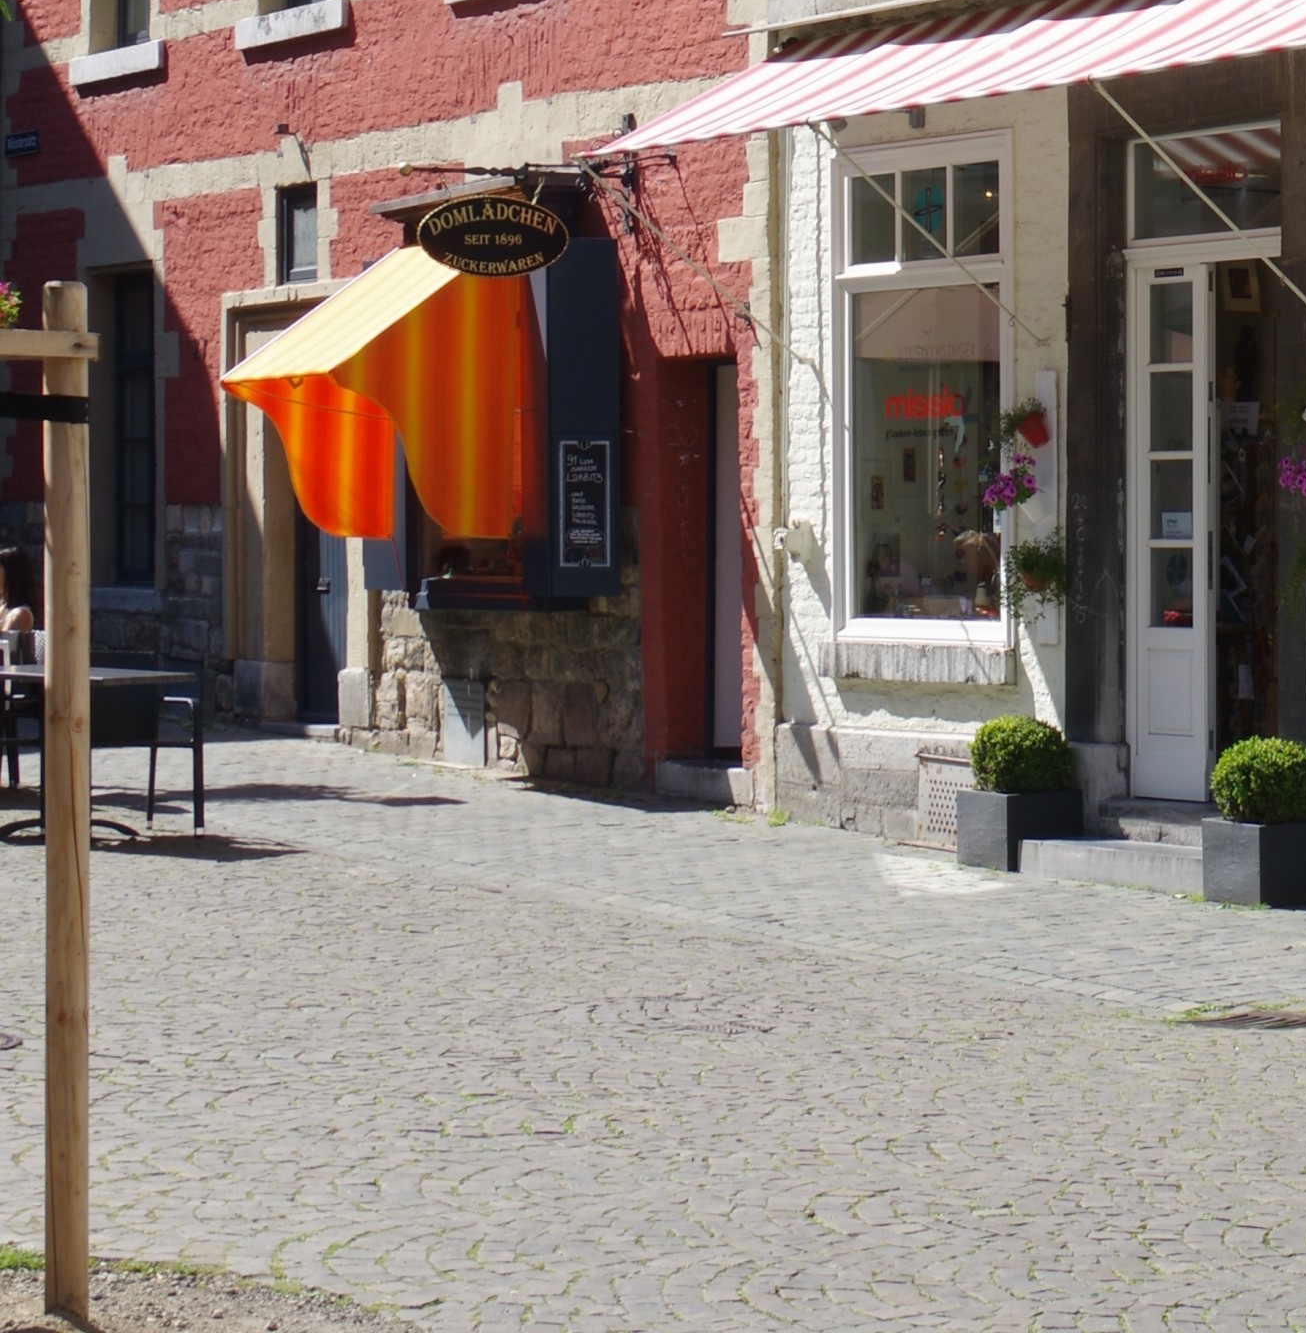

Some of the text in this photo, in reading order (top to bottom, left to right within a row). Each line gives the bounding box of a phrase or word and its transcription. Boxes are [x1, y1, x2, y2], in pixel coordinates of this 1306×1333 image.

[428, 199, 558, 235] DOMLÄDCHEN
[464, 234, 523, 246] SEIT 1896
[442, 251, 545, 274] ZUCKERWAREN
[885, 384, 966, 421] missio
